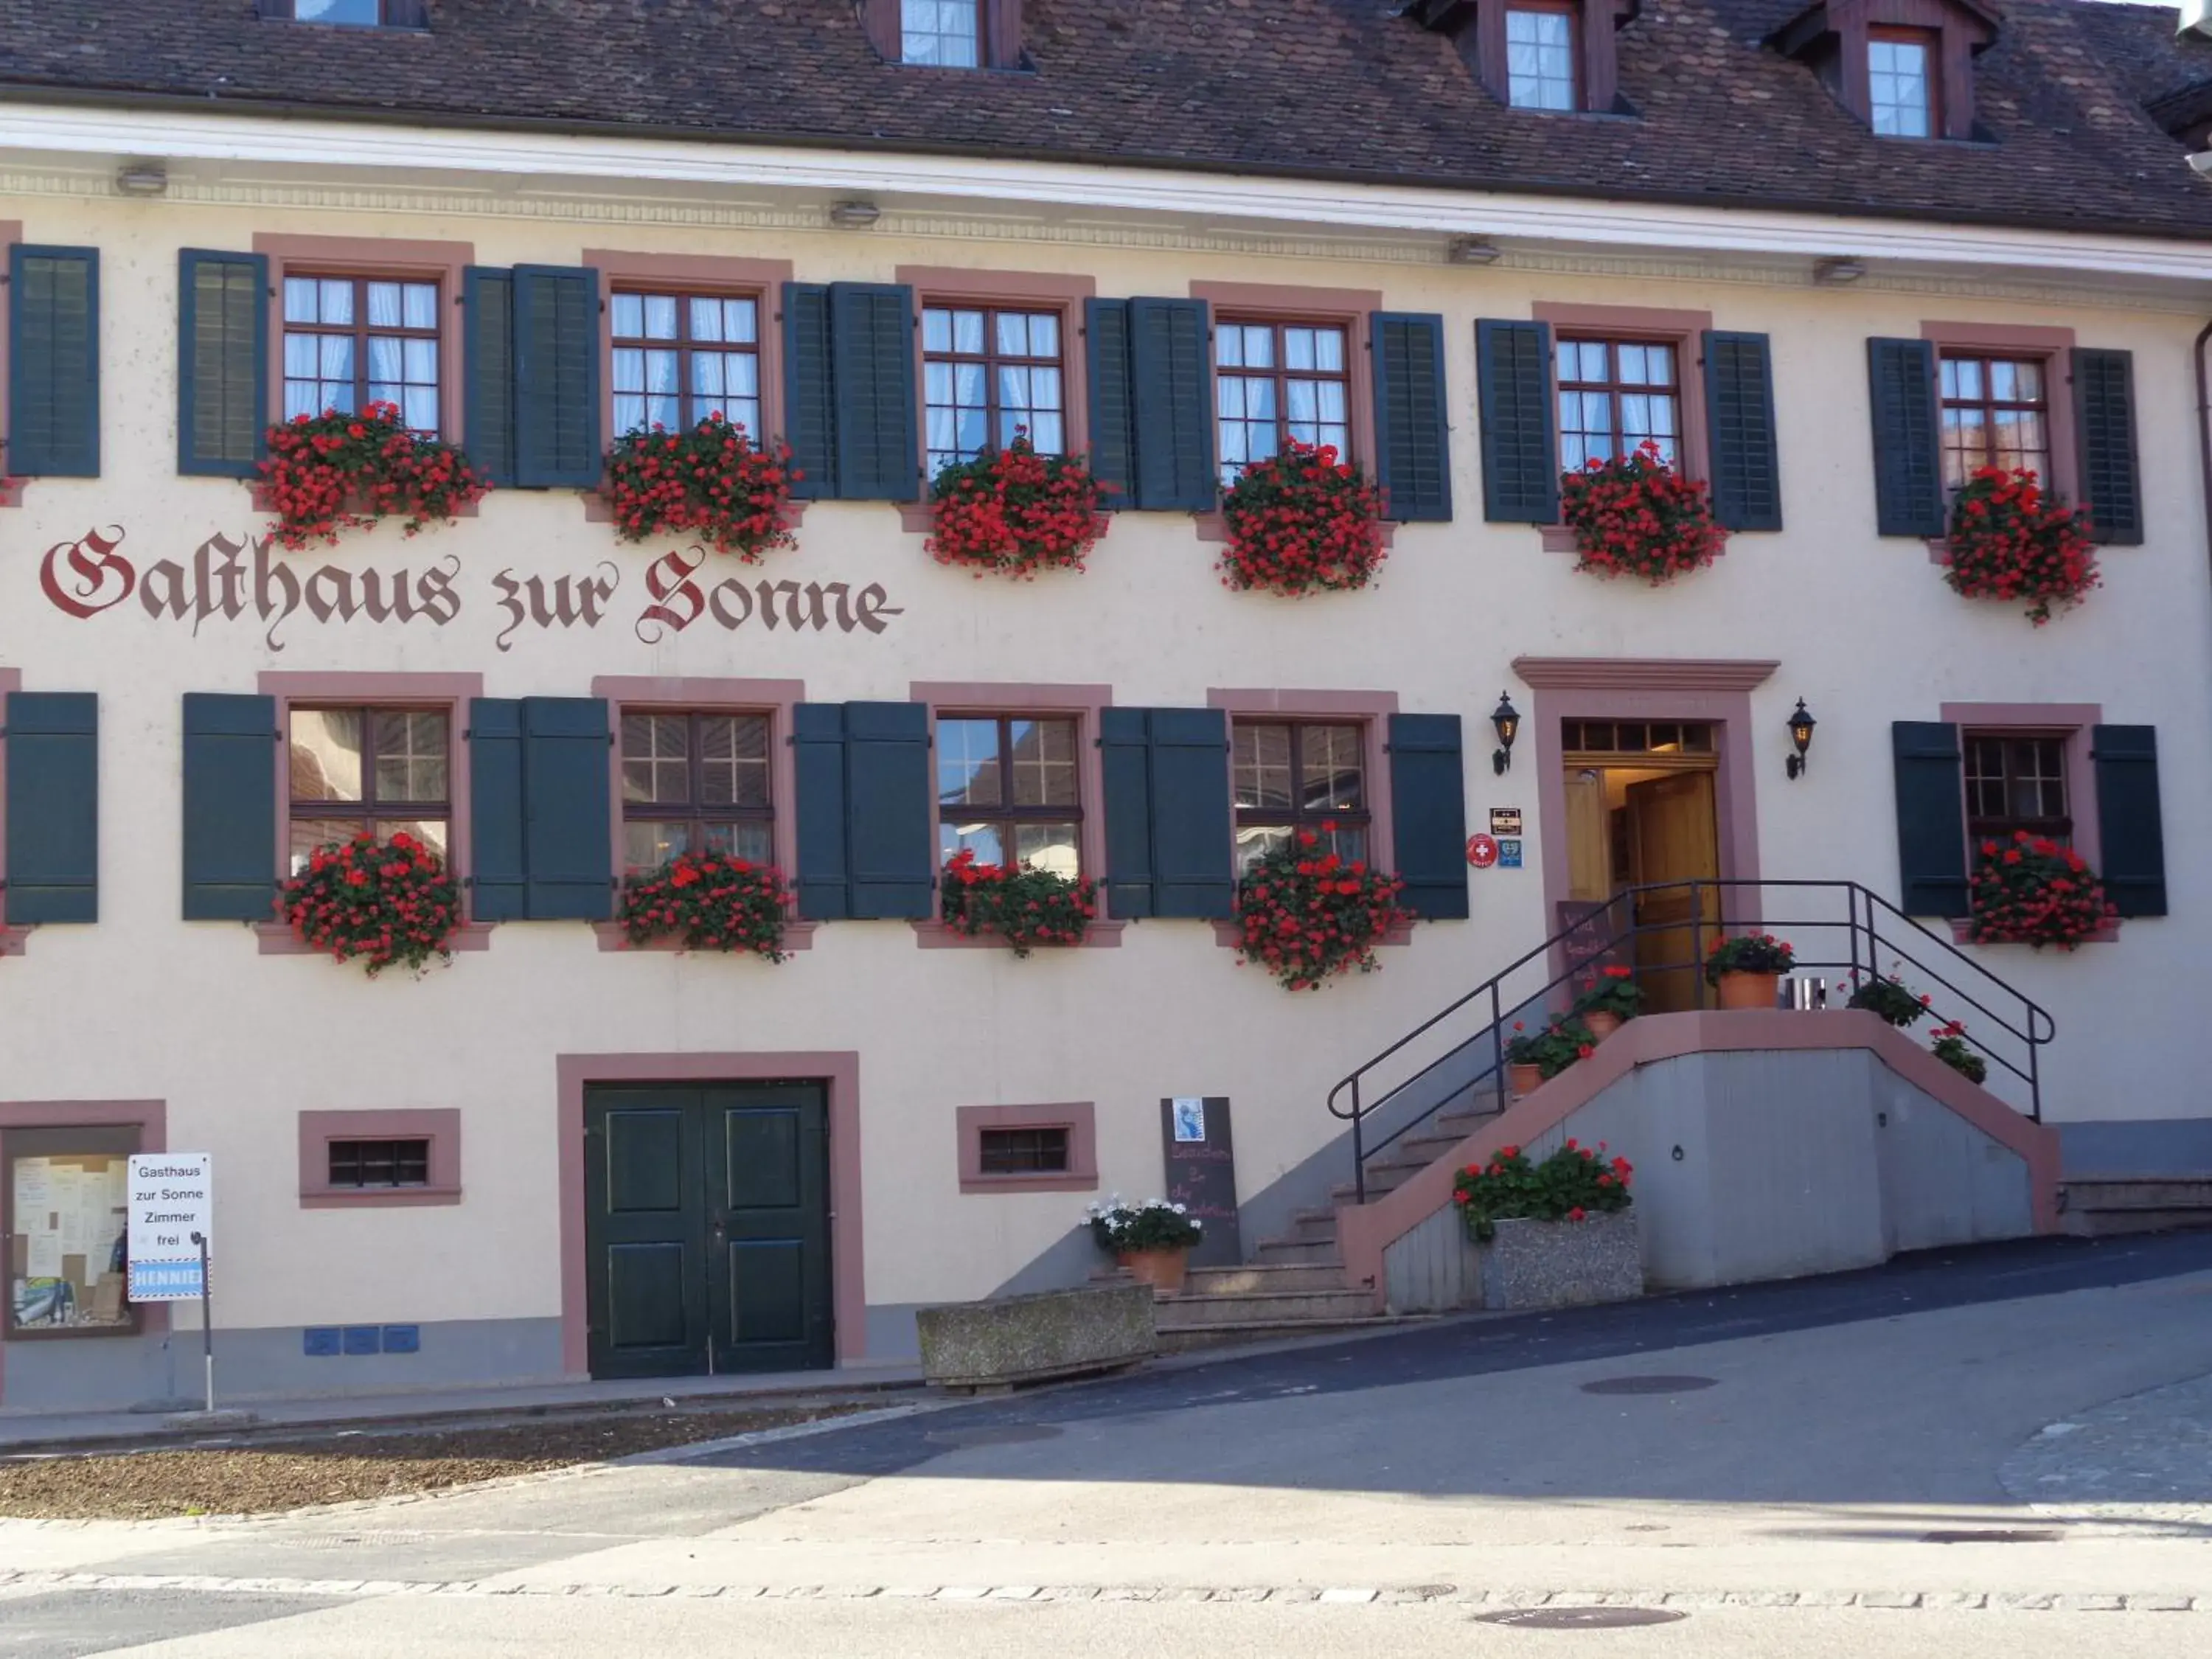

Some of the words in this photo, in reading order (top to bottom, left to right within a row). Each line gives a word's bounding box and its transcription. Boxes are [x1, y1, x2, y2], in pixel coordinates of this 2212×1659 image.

[492, 560, 620, 652] zur
[635, 545, 905, 644] Sonne
[139, 1166, 201, 1178] Gasthaus
[136, 1192, 157, 1201] zur
[161, 1189, 204, 1200] Sonne
[145, 1211, 195, 1224] Zimmer
[157, 1234, 180, 1246] frei
